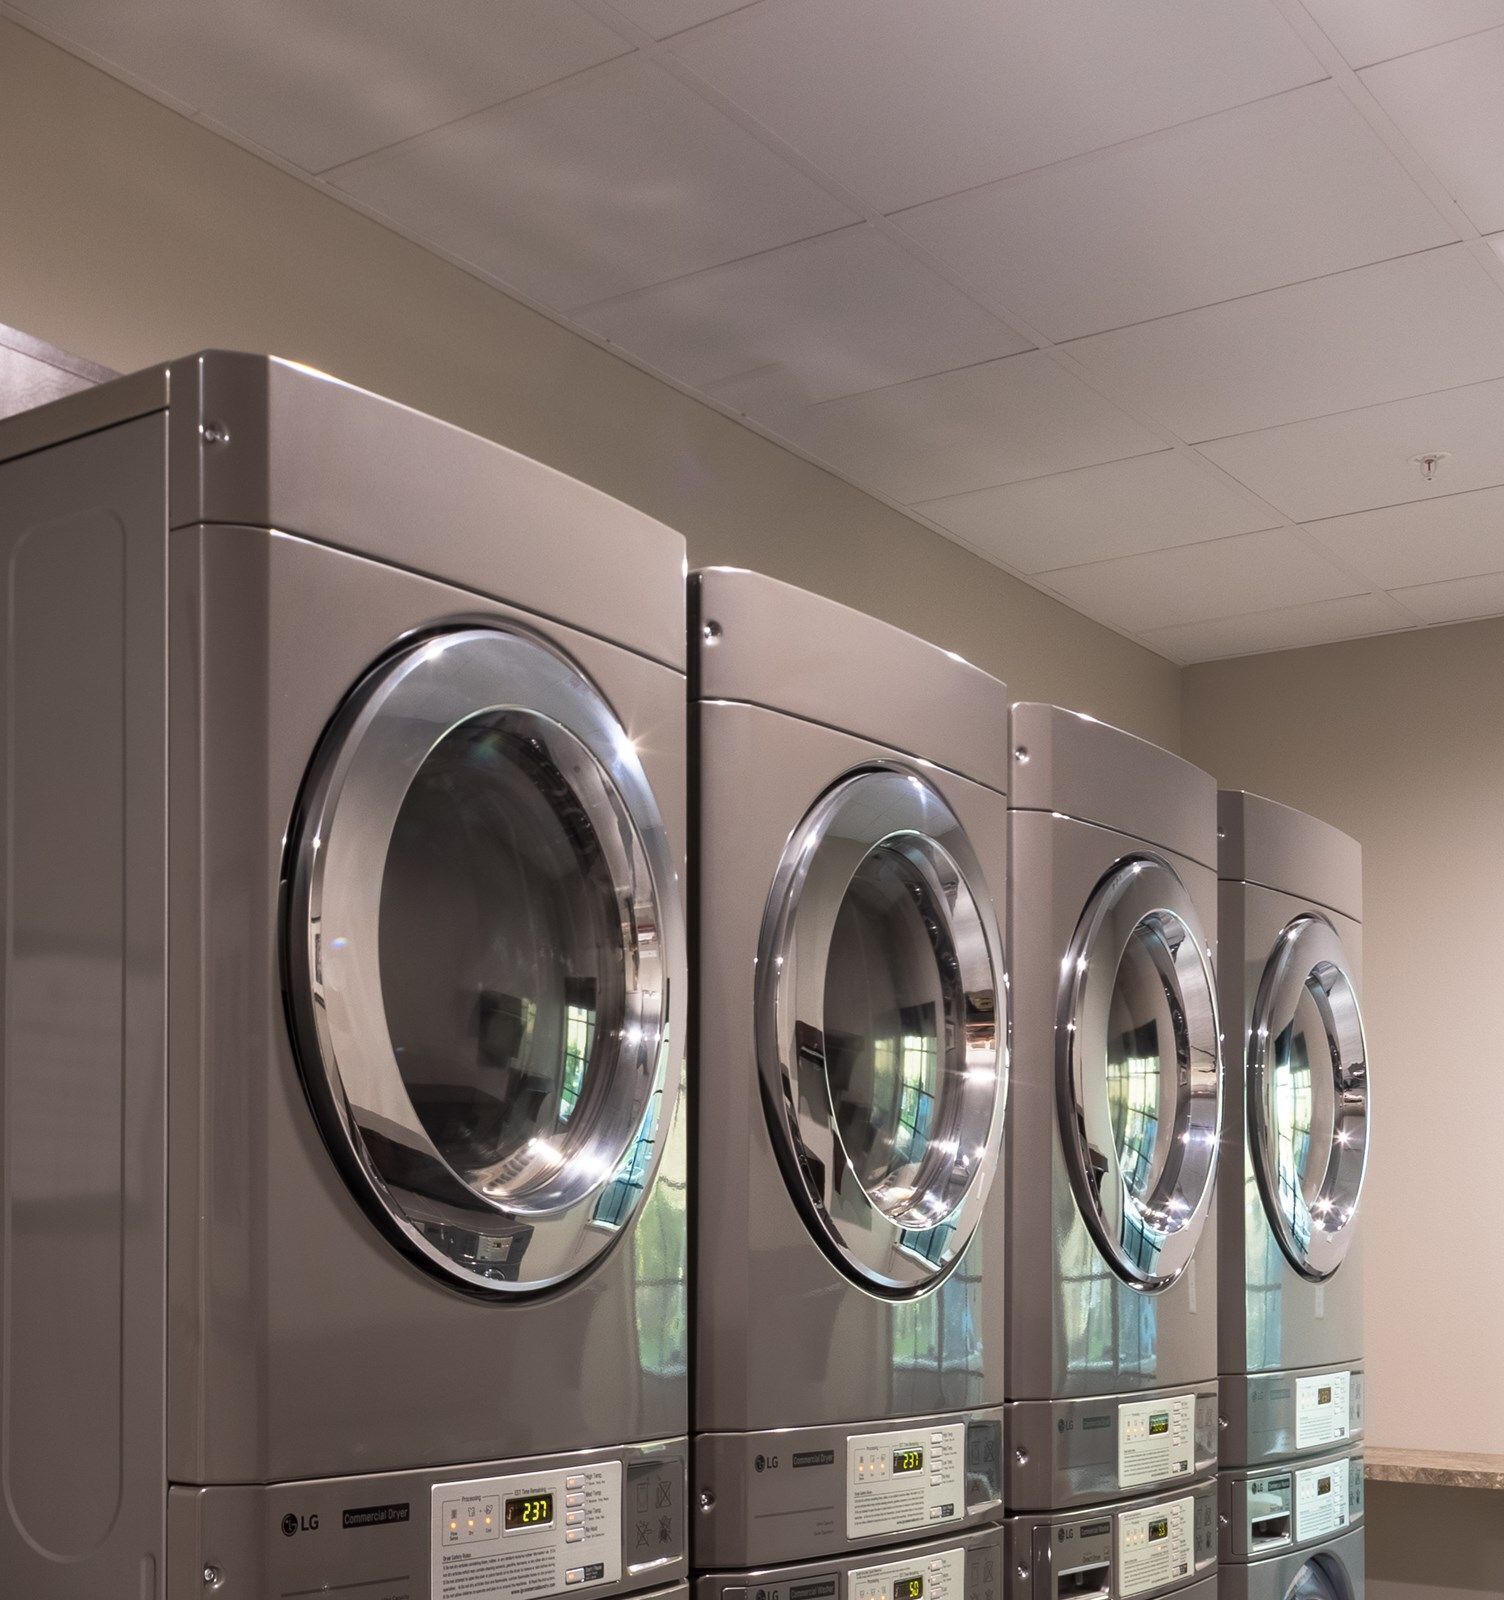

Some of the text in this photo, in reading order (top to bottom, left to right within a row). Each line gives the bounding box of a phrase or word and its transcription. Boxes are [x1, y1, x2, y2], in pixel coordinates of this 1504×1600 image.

[767, 1456, 779, 1469] LG
[344, 1508, 409, 1525] Commercial Dryer
[523, 1501, 547, 1522] 237
[301, 1514, 320, 1531] LG
